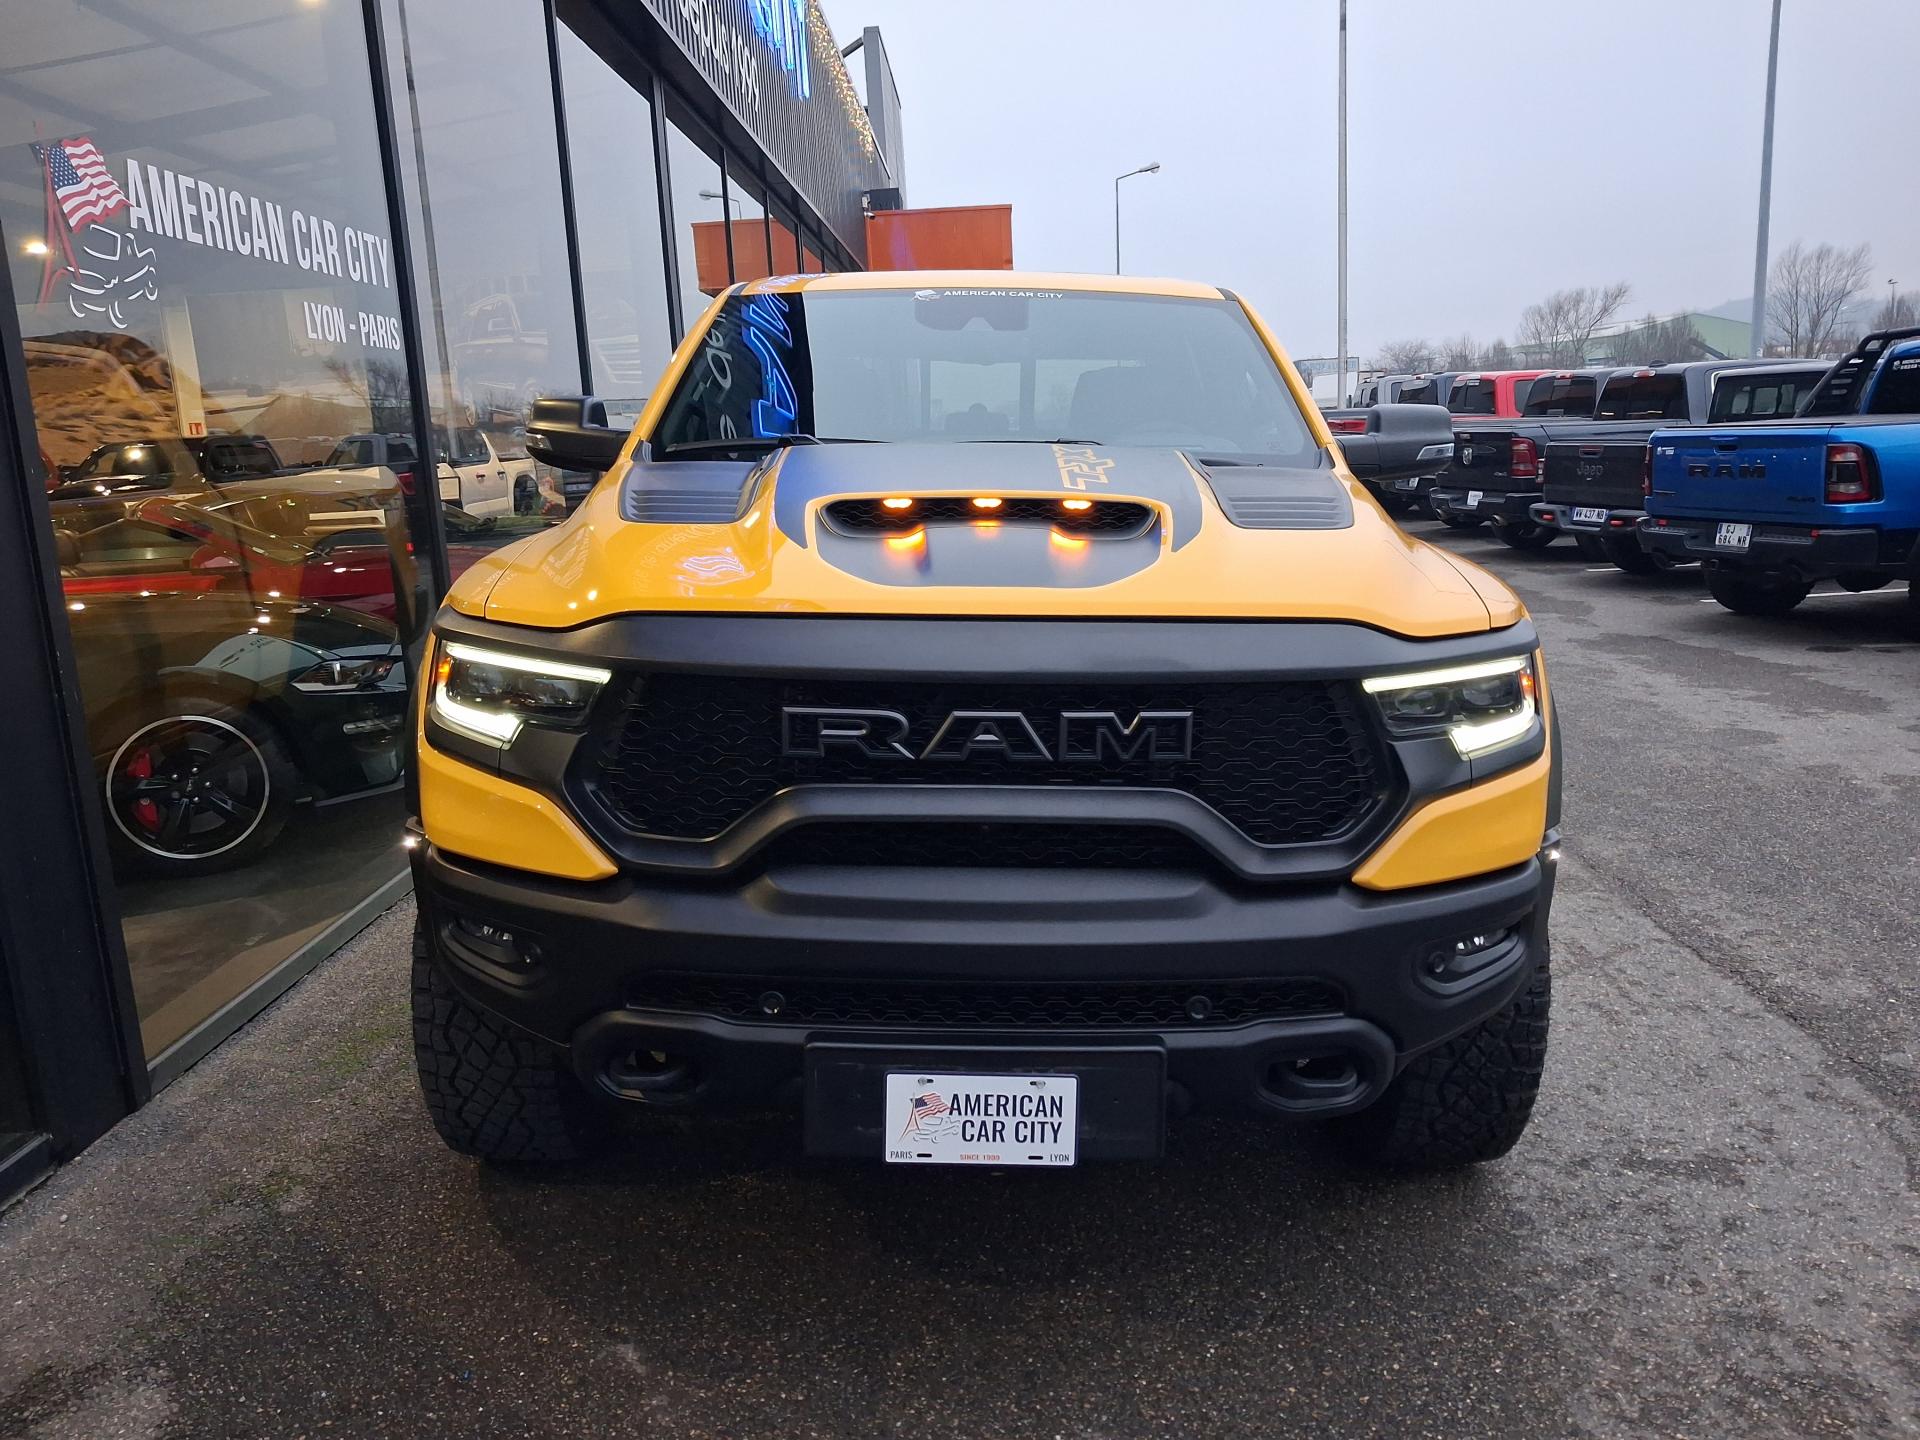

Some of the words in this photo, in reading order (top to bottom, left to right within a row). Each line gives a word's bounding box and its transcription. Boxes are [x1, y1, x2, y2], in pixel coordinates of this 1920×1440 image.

[729, 27, 759, 112] 1999
[126, 158, 289, 265] AMERICAN
[291, 210, 343, 278] CAR
[344, 226, 389, 288] CITY
[303, 301, 347, 343] LYON
[358, 311, 400, 350] PARIS
[1687, 464, 1766, 479] RAM
[782, 706, 1194, 760] RAM
[949, 1093, 1063, 1118] AMERICAN
[961, 1120, 1006, 1143] CAR
[1014, 1121, 1062, 1144] CITY
[890, 1151, 913, 1160] PARIS
[1050, 1154, 1070, 1163] LYON
